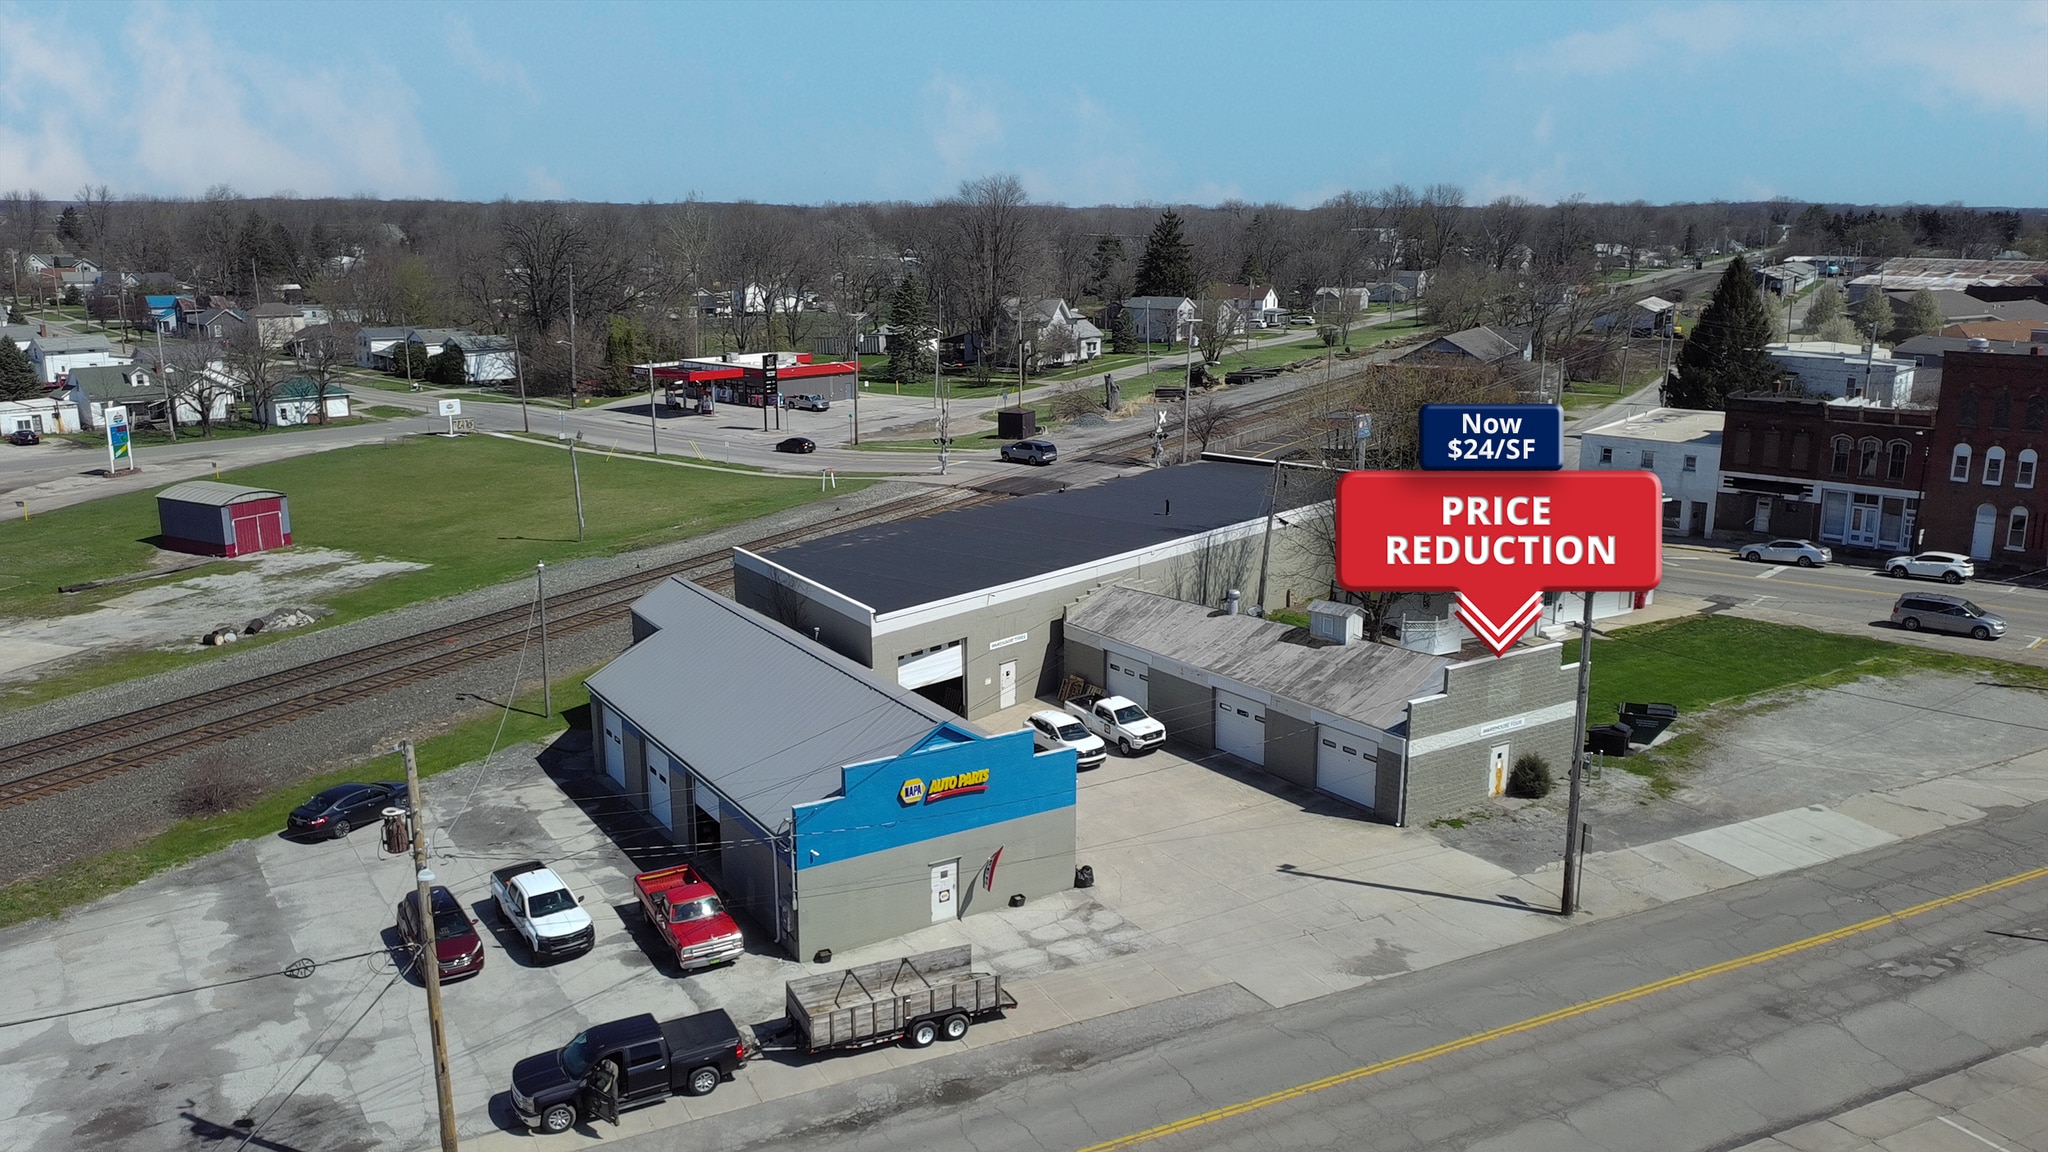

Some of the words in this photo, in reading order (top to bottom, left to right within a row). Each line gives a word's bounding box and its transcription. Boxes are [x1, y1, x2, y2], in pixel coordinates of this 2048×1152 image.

[904, 784, 922, 798] NAPA
[928, 775, 957, 794] AUTO
[958, 768, 990, 787] PARTS
